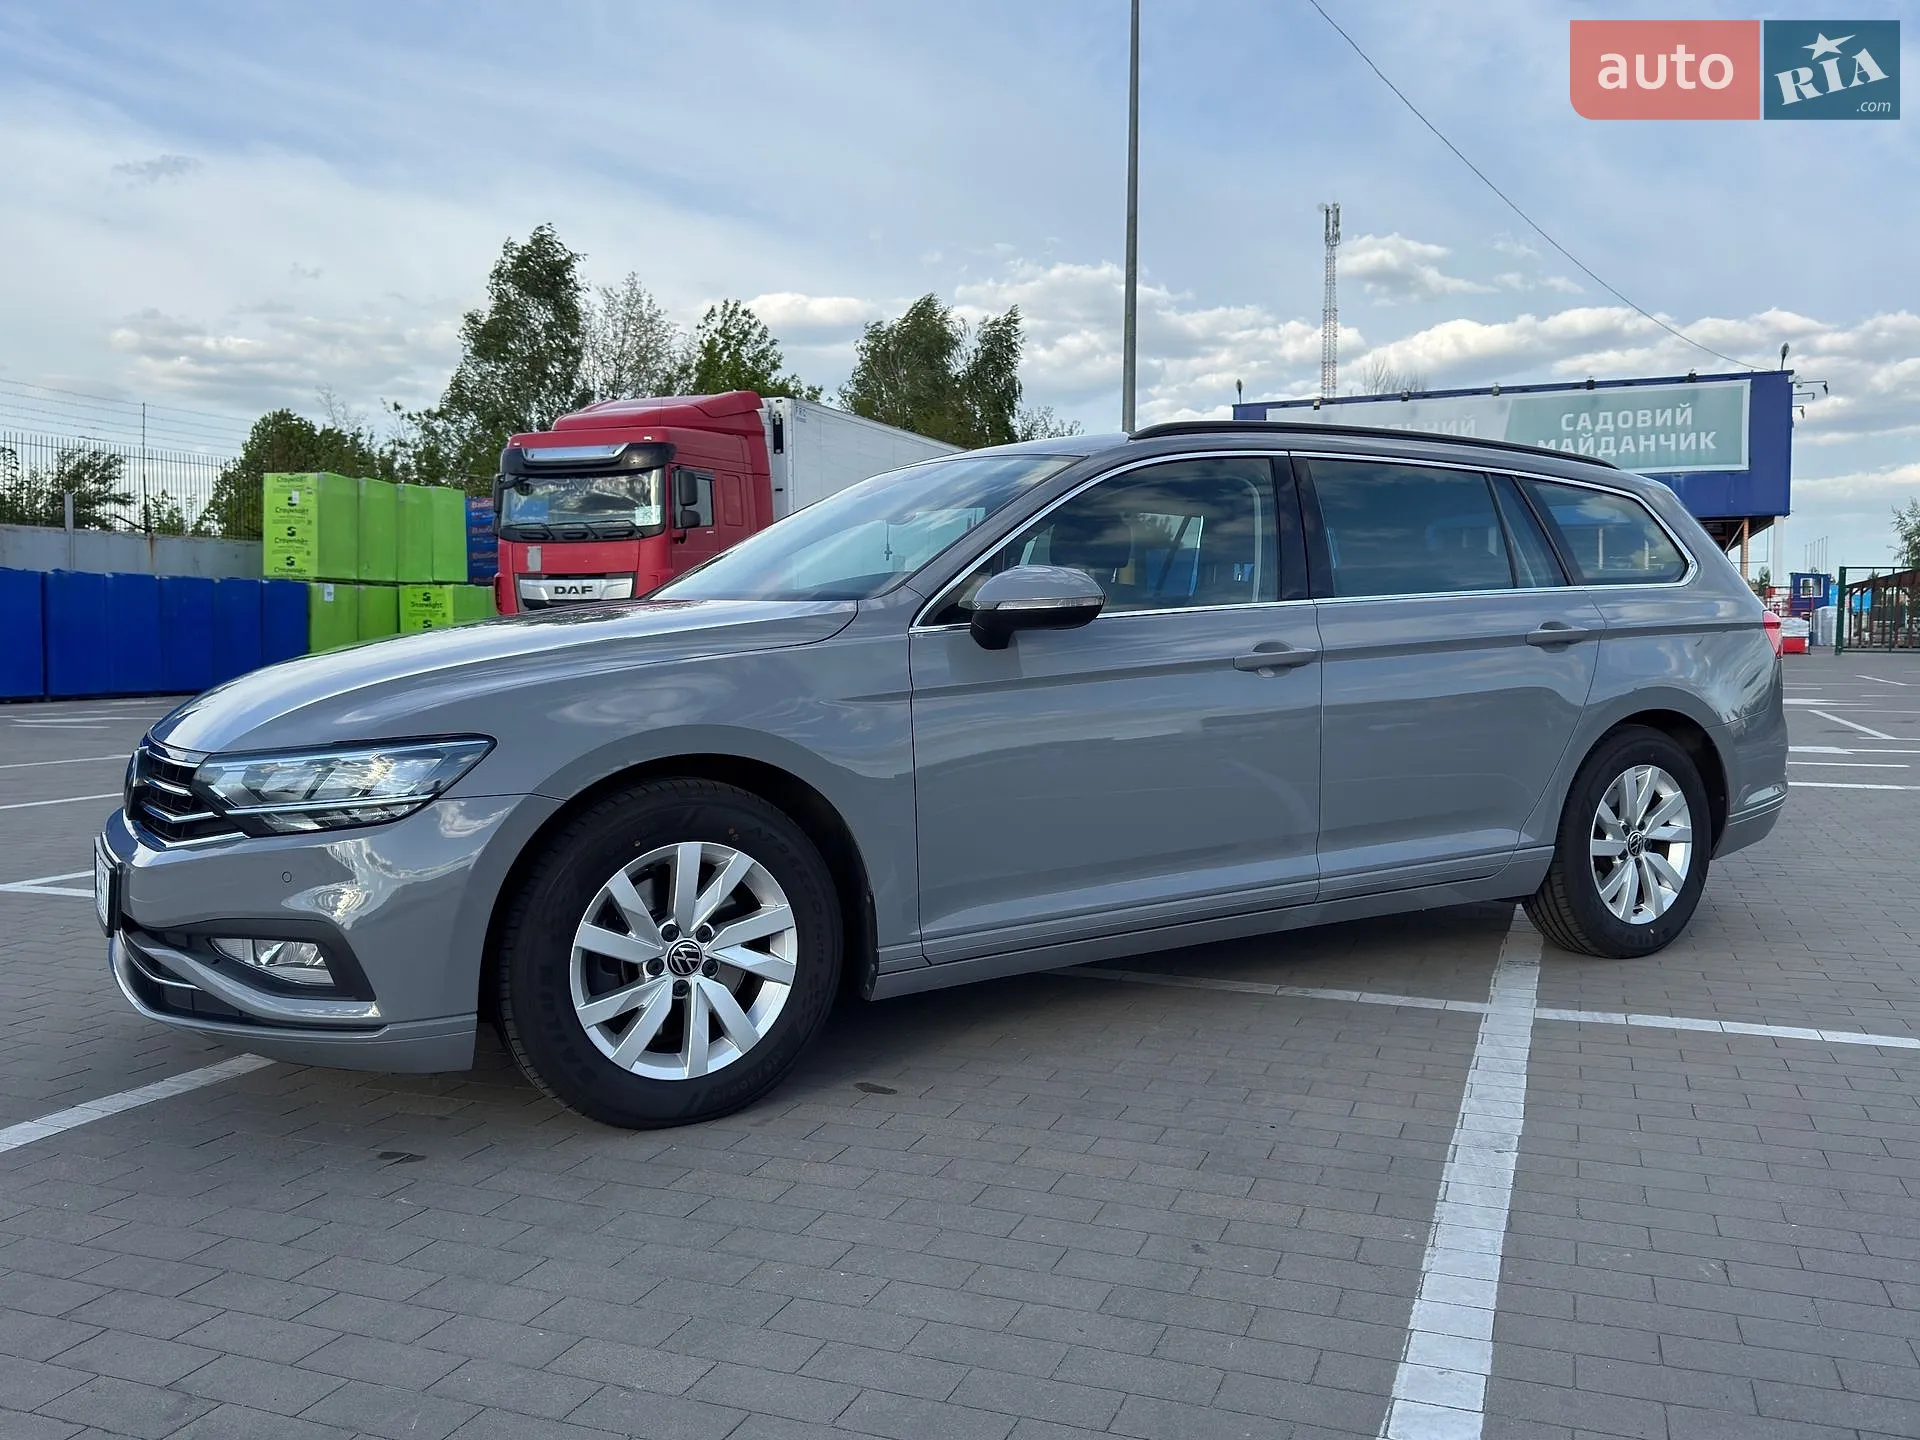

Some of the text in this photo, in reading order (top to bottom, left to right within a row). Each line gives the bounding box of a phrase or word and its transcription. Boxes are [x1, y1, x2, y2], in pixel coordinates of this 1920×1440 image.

[1560, 402, 1693, 433] САДОВИЙ
[1536, 431, 1718, 457] МАЙДАНЧИК
[554, 585, 593, 595] DAF
